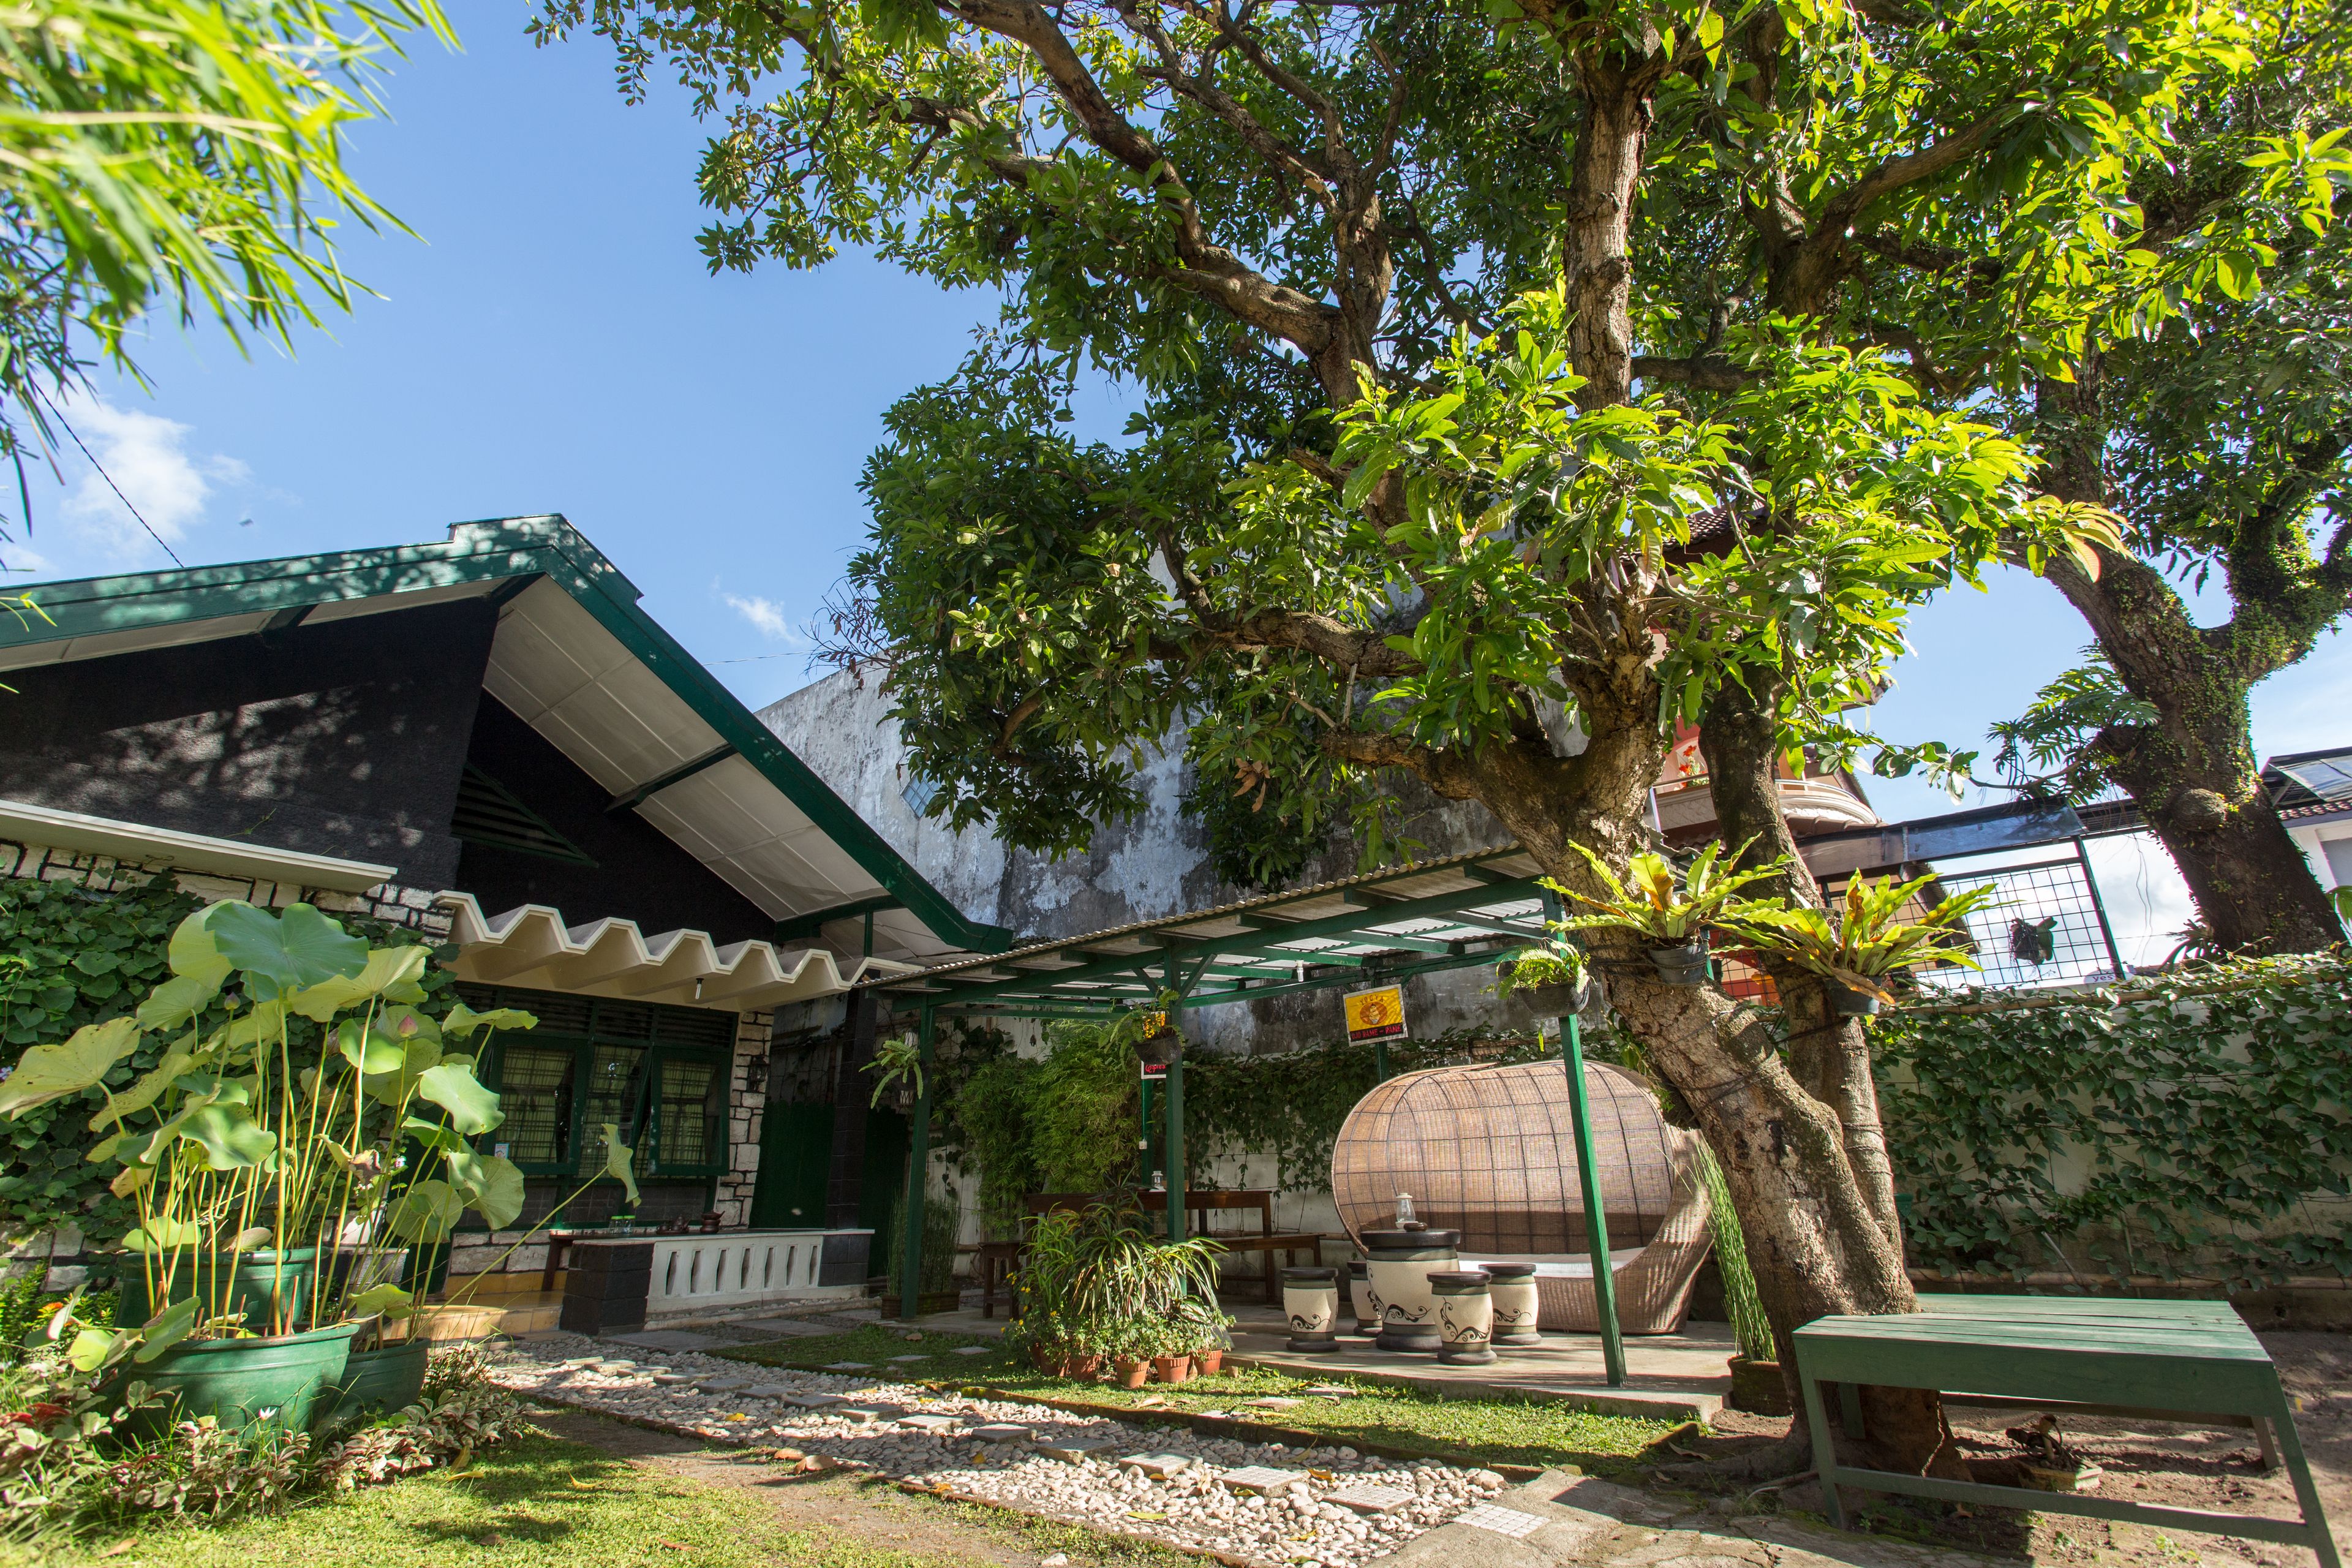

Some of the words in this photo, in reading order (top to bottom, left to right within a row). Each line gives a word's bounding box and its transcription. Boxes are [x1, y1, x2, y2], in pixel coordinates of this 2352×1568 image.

[1360, 994, 1384, 1005] YOGYA
[1362, 1028, 1378, 1038] RAME
[1385, 1024, 1401, 1035] RAME
